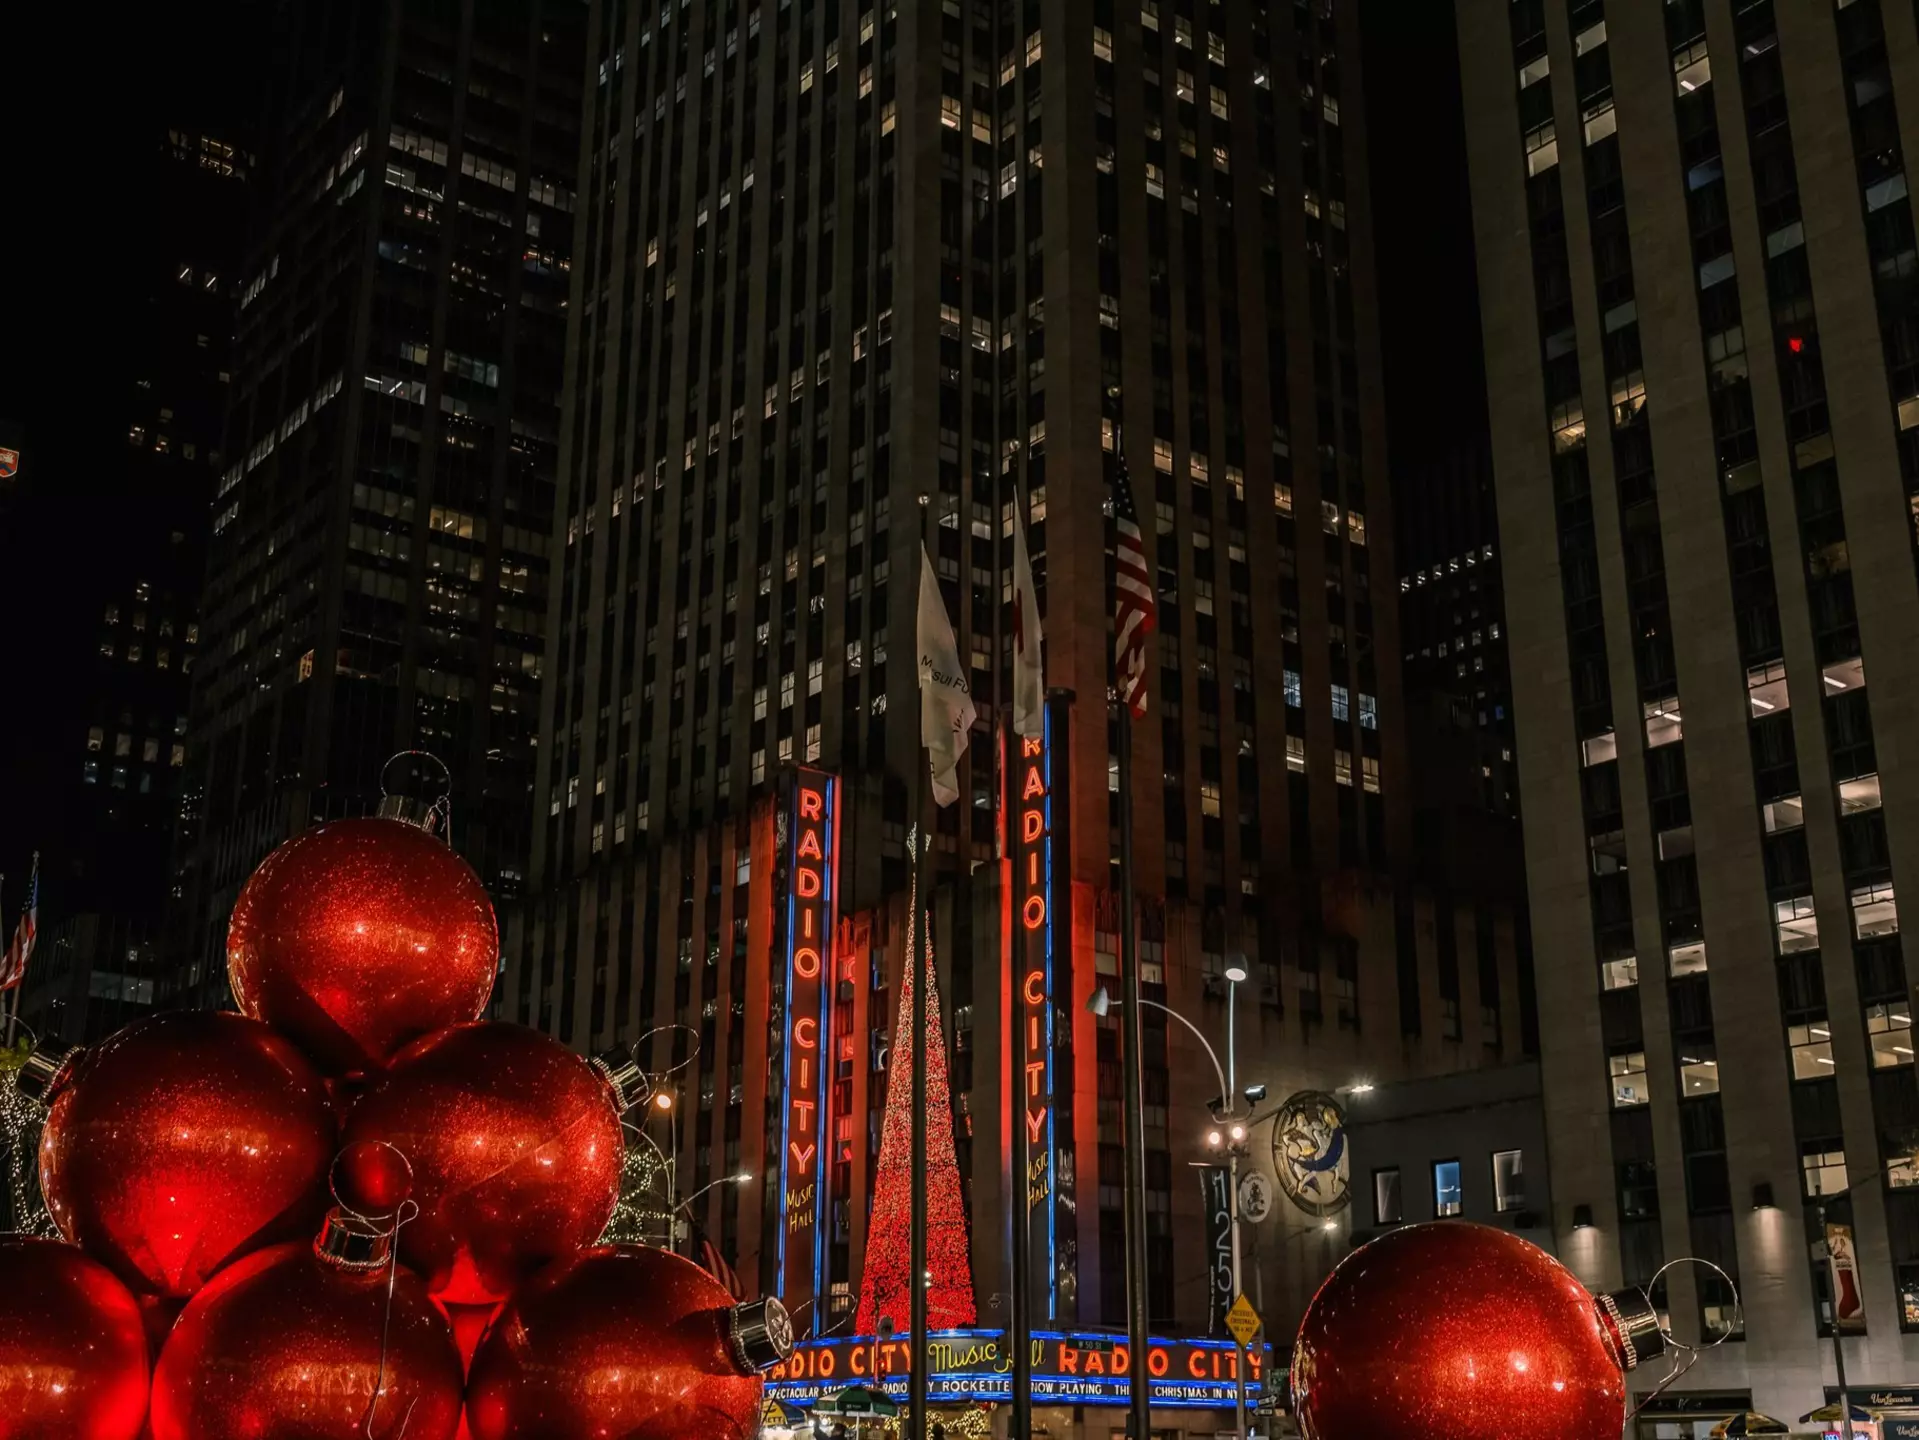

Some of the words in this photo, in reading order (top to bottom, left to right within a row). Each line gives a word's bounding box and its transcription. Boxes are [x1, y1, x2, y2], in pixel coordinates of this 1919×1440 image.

[794, 788, 822, 978] RADIO
[1025, 971, 1047, 1143] CITY
[790, 1018, 816, 1175] CITY
[786, 1184, 814, 1211] MUSIC
[790, 1215, 814, 1235] HALL
[763, 1349, 835, 1380] ADIO
[1059, 1343, 1169, 1377] RADO
[1189, 1350, 1262, 1380] CITY
[768, 1386, 818, 1399] SPECTACULAR
[883, 1382, 907, 1394] RADIO
[942, 1380, 1010, 1392] ROCKETTE
[1031, 1382, 1053, 1393] NOW
[1060, 1383, 1102, 1395] PLAYING
[1114, 1384, 1130, 1396] THI
[1155, 1386, 1208, 1398] CHRISTMAS
[1213, 1388, 1222, 1399] IN
